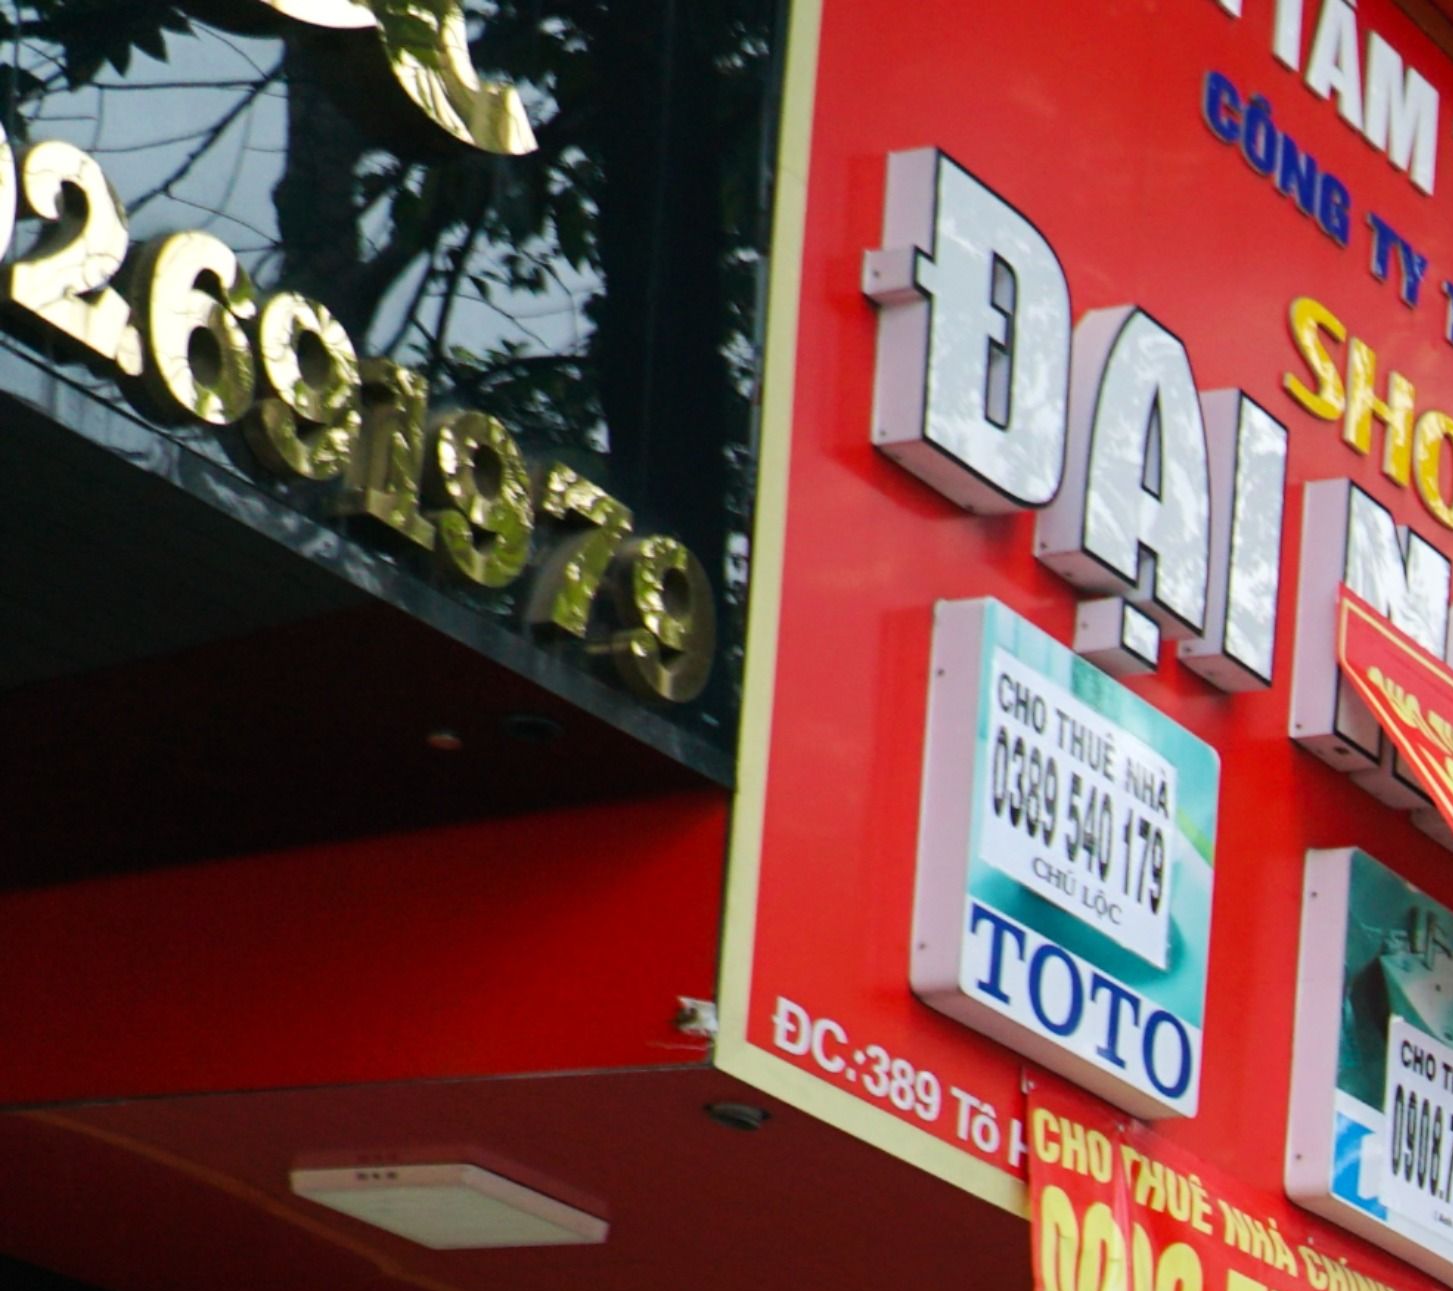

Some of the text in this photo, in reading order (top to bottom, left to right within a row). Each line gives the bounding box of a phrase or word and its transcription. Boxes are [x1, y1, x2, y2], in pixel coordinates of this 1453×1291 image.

[1203, 69, 1351, 250] CÔNG
[1366, 211, 1428, 307] TY
[865, 146, 1288, 692] ĐẠI
[991, 727, 1166, 915] 0389 540 179
[997, 672, 1170, 819] CHO THUÊ NHÀ
[1032, 854, 1124, 927] CHÚ LỘC
[970, 902, 1194, 1100] TOTO
[1400, 1040, 1436, 1082] CHO
[951, 1085, 1001, 1153] Tô
[1032, 1105, 1113, 1184] CHO
[1121, 1143, 1214, 1238] THUÊ
[1219, 1196, 1299, 1279] NHÀ
